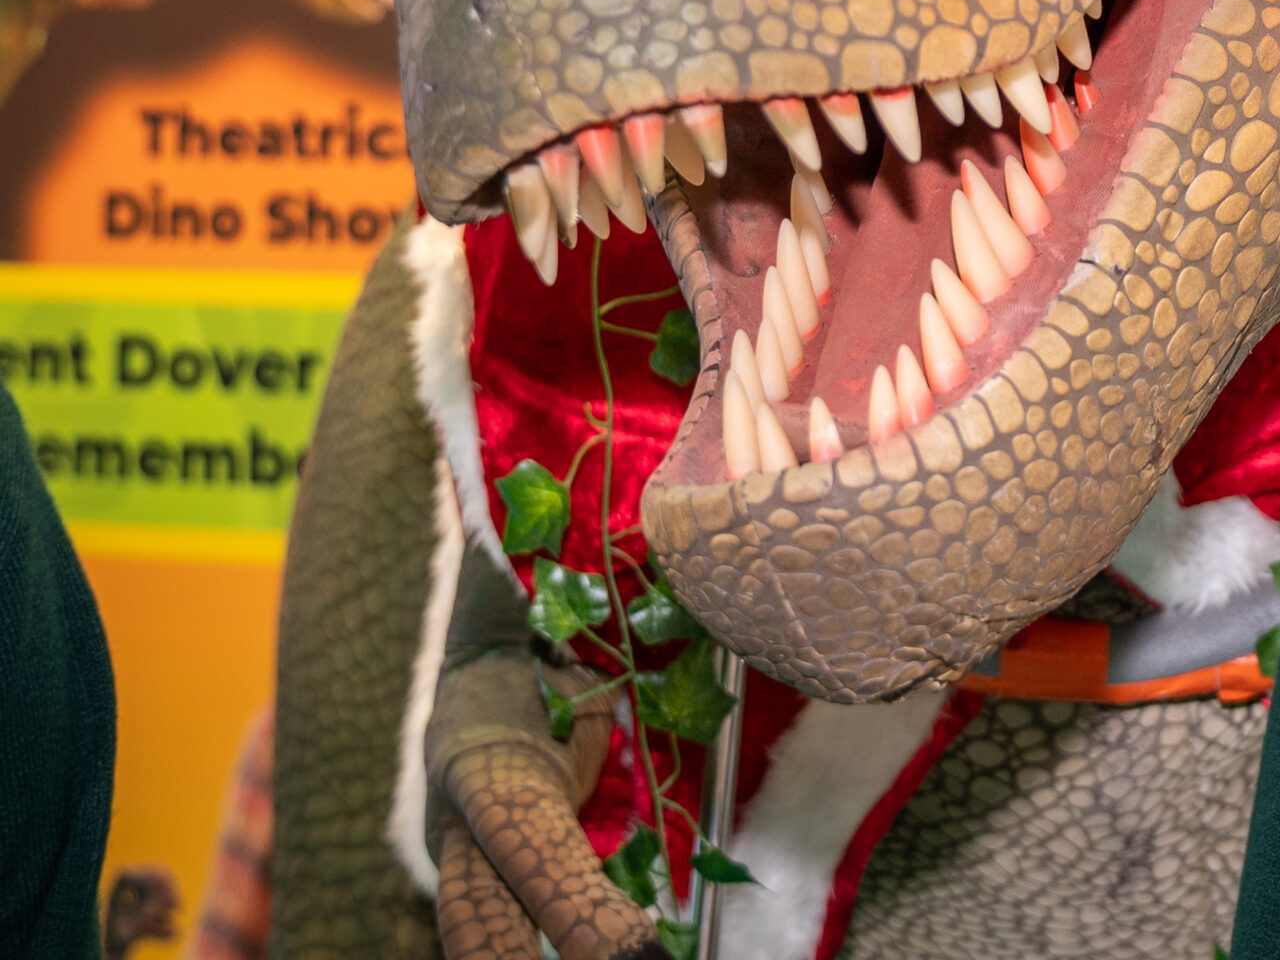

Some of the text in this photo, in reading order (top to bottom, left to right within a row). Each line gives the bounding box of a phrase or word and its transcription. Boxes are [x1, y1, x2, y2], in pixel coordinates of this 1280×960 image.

[142, 102, 412, 159] Theatric
[105, 187, 398, 243] Dino Sho
[117, 336, 319, 391] Dover
[36, 428, 307, 487] ememb
